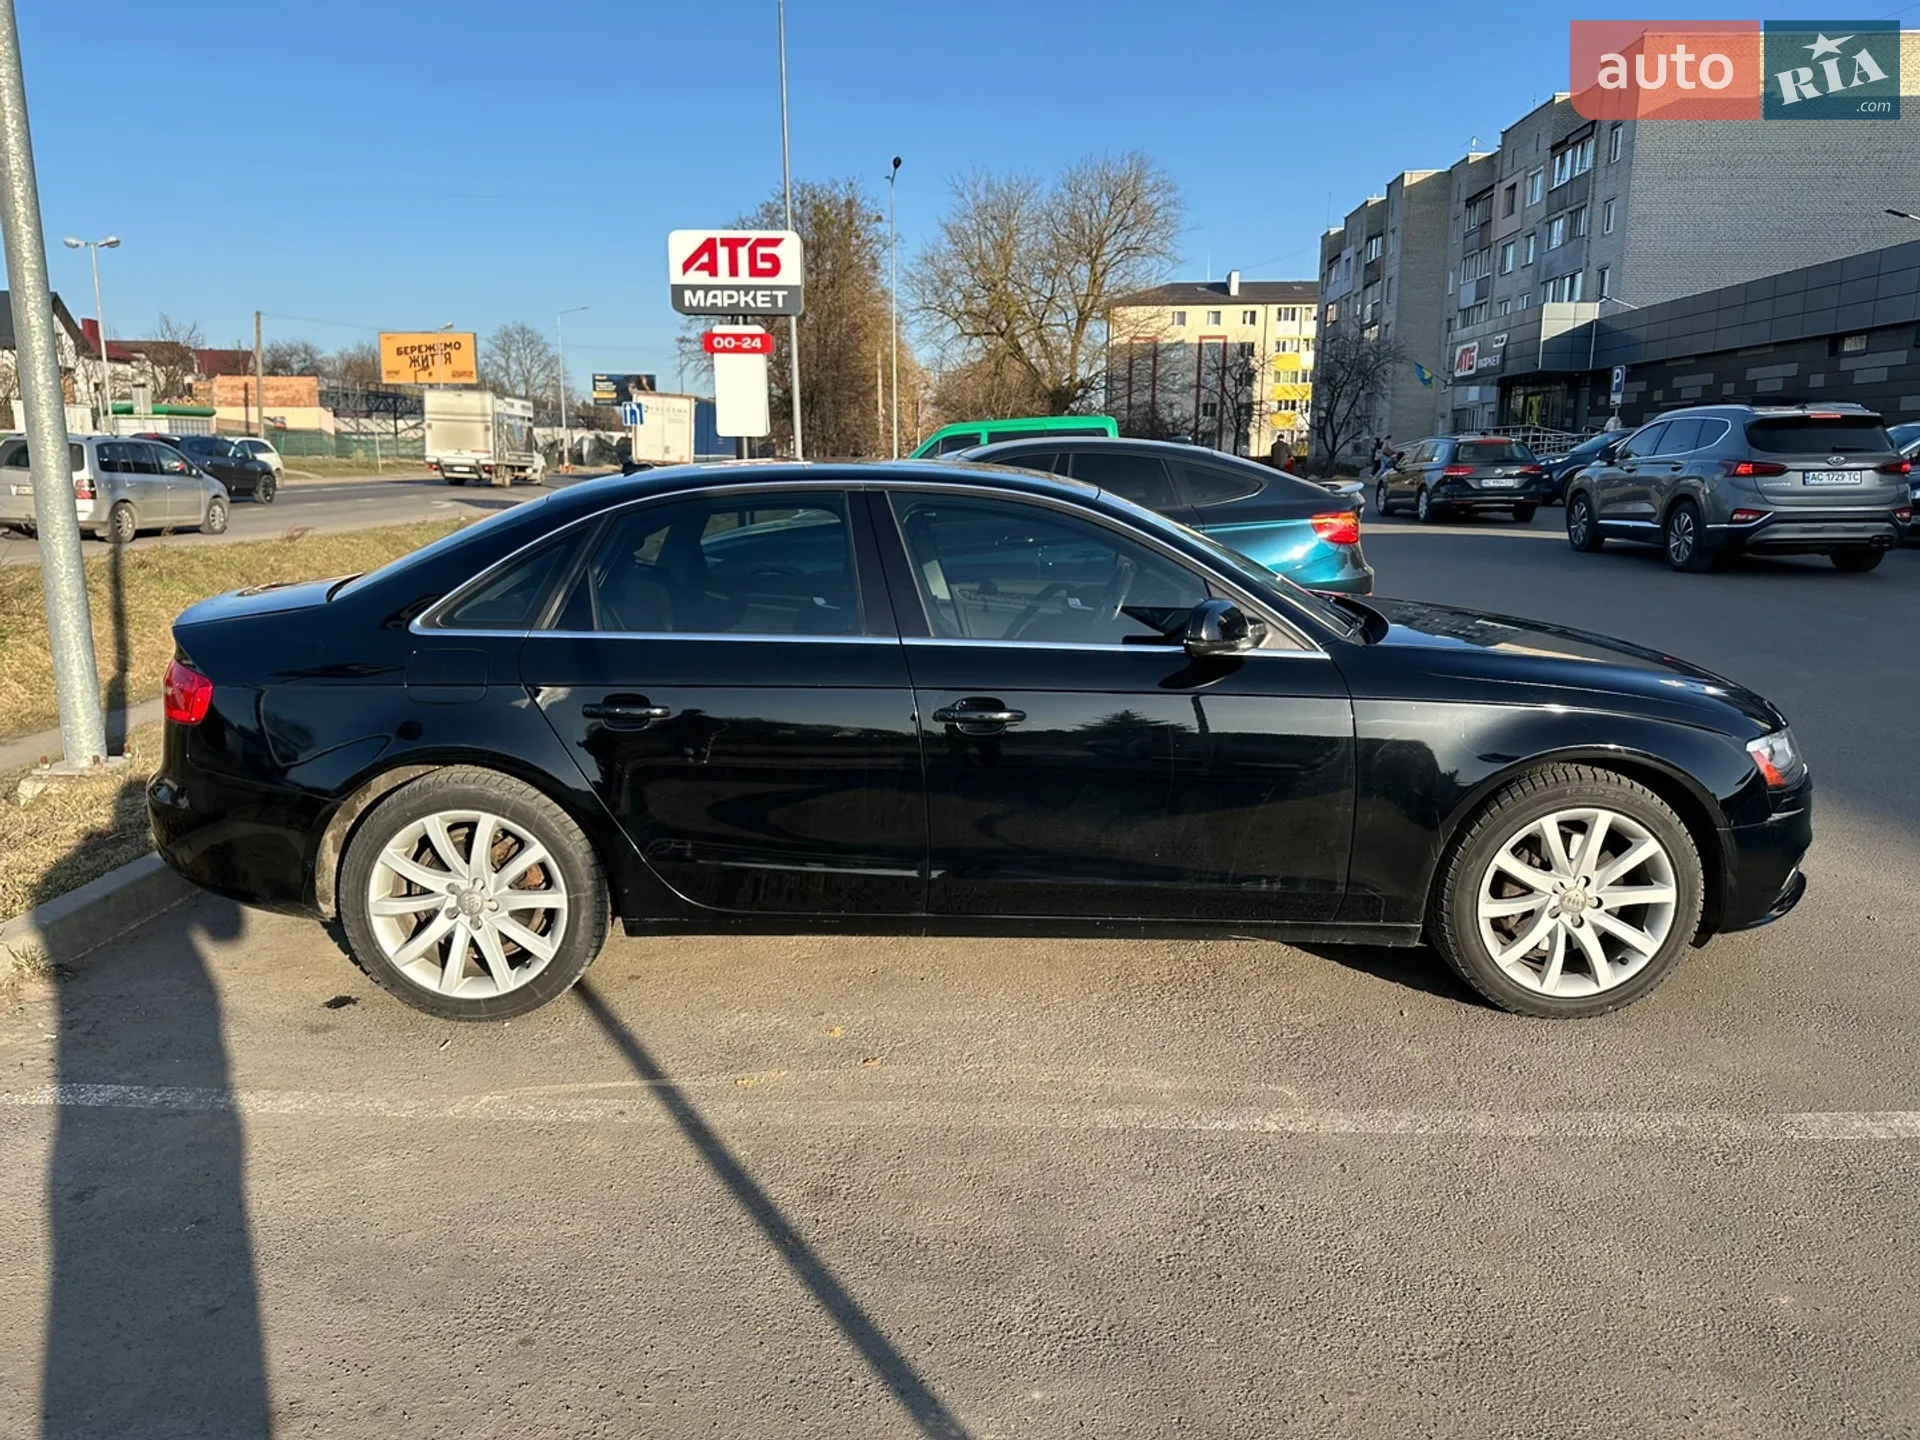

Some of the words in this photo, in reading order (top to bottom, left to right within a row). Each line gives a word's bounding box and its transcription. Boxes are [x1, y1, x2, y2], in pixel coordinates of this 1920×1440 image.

[682, 237, 785, 278] АТБ
[684, 290, 788, 308] МАРКЕТ
[712, 336, 762, 349] 00-24
[1810, 473, 1824, 482] AC
[1847, 472, 1860, 481] TC
